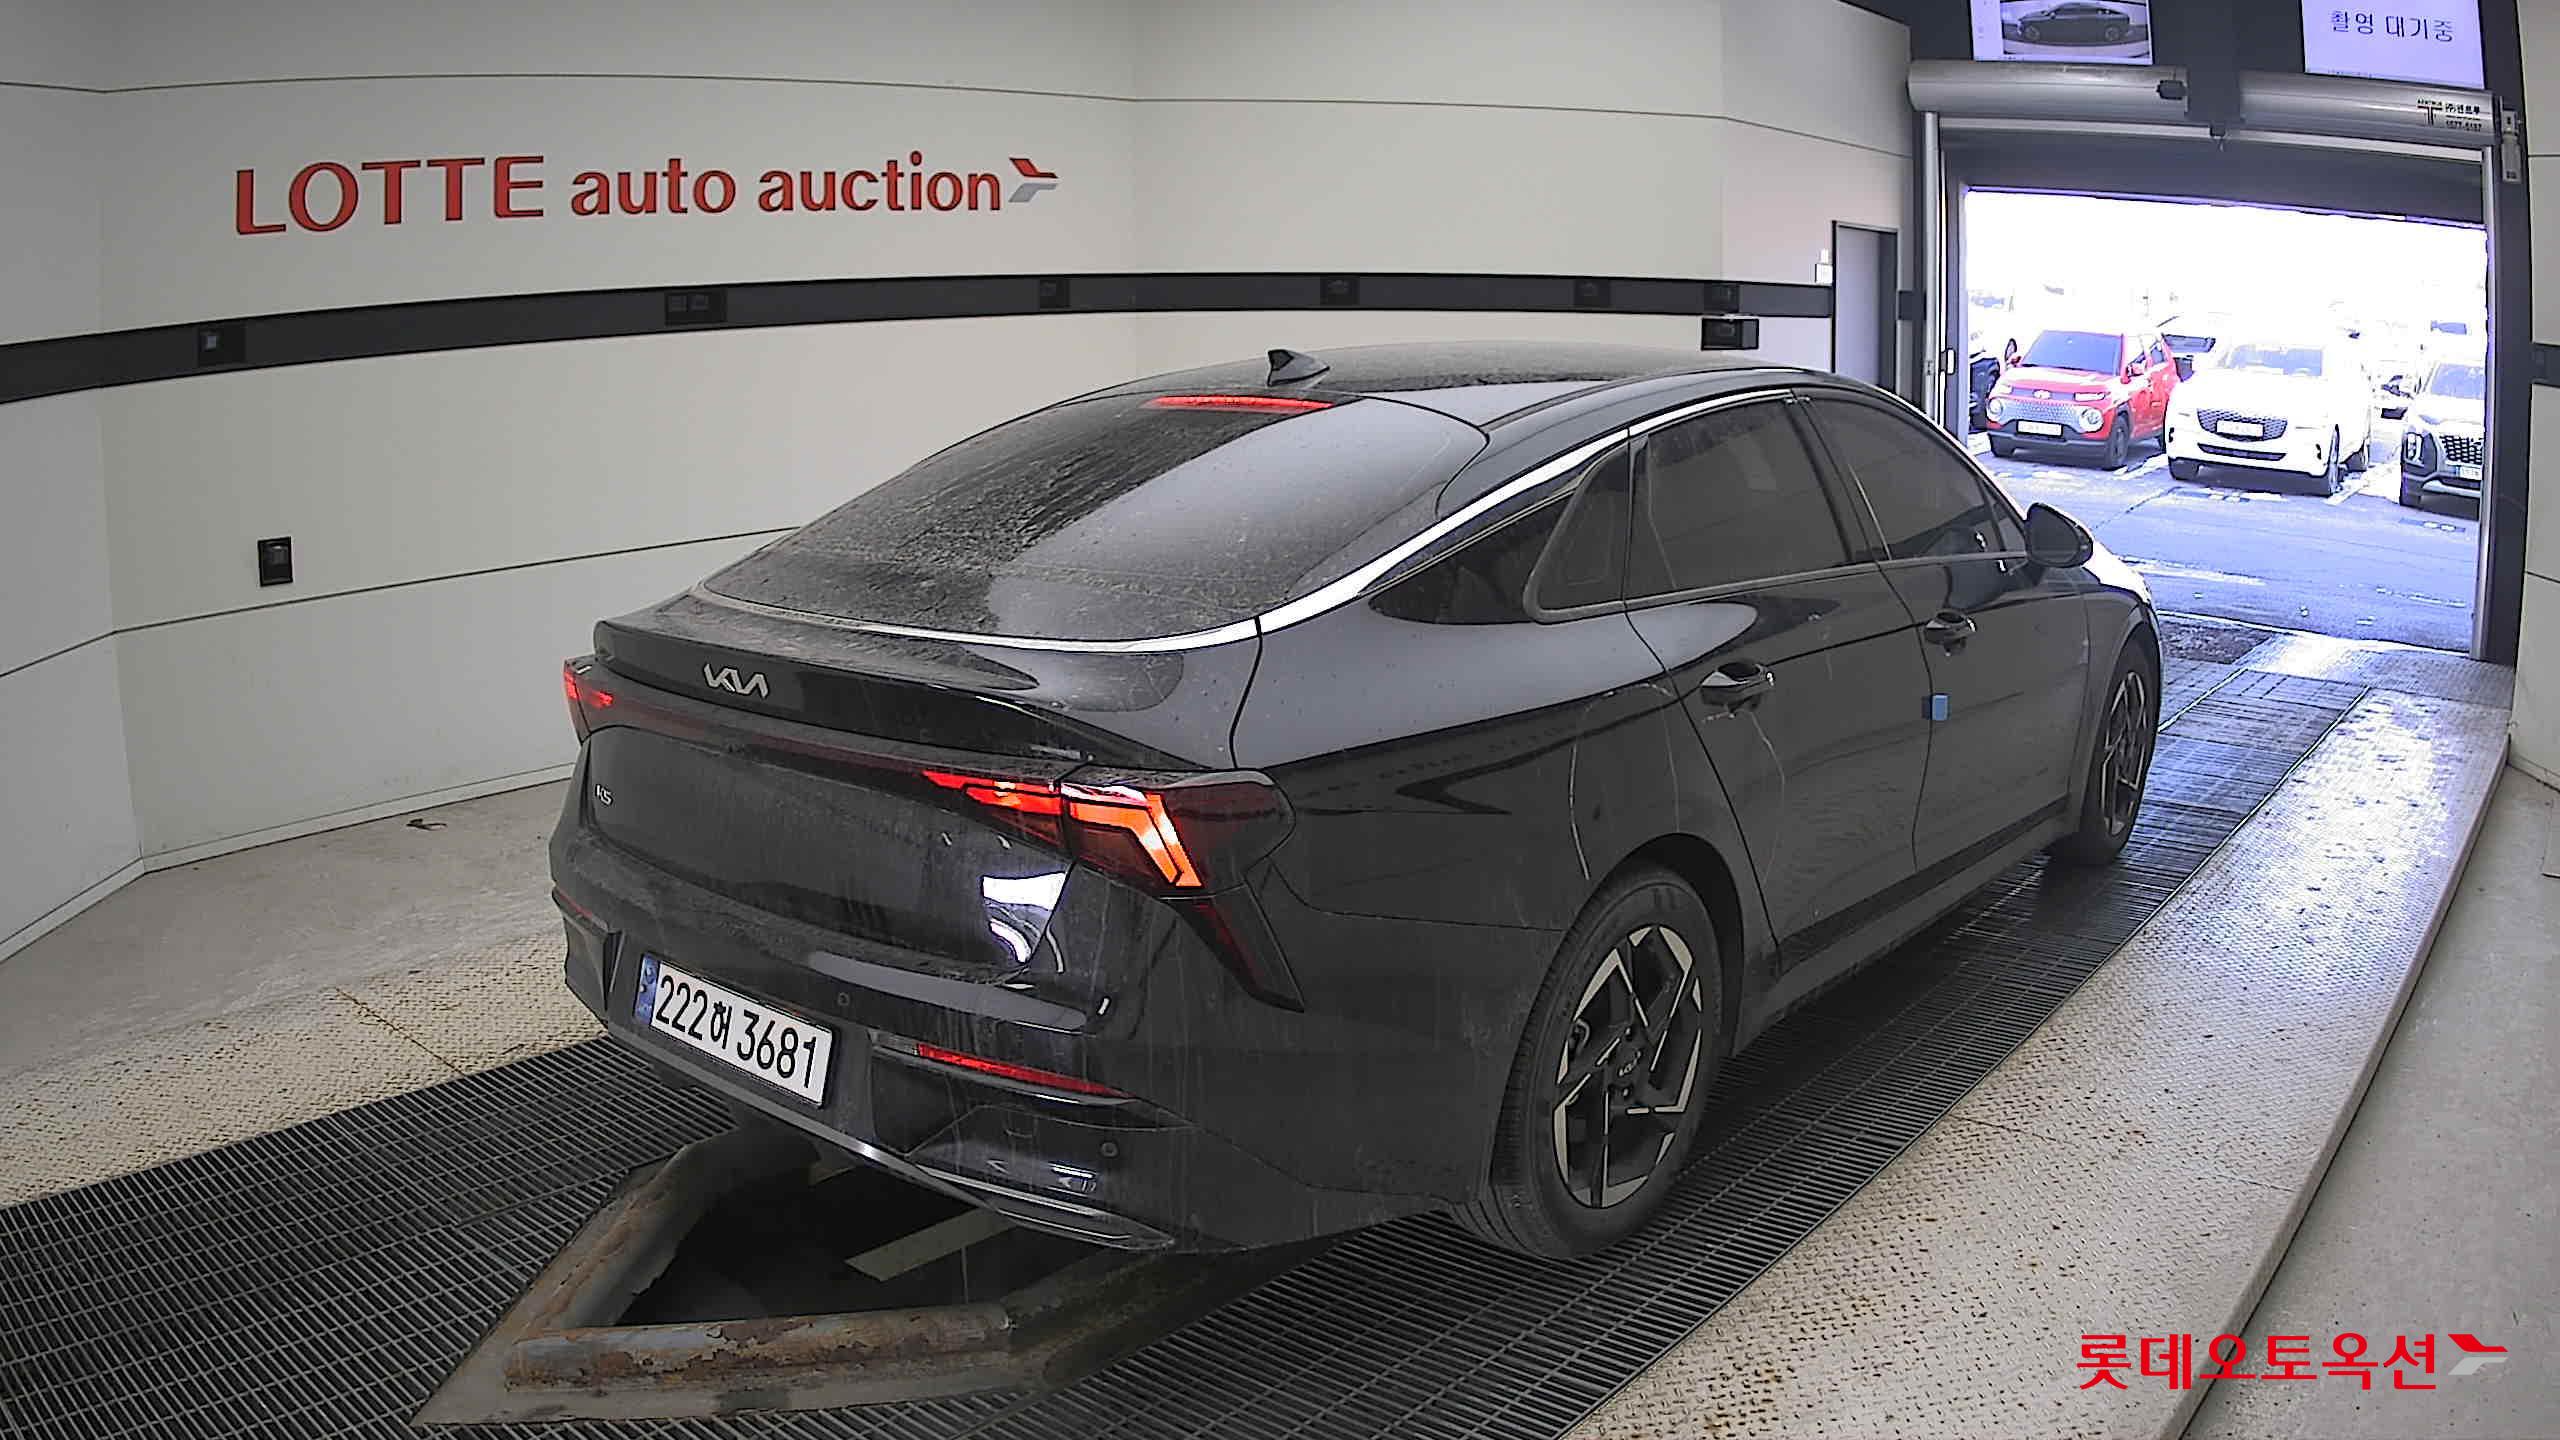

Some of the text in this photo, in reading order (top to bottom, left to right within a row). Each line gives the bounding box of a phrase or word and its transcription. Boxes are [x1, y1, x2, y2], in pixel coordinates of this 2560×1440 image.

[2331, 10, 2453, 42] 촬영 대기중
[236, 150, 1001, 235] LOTTE auto auction
[703, 663, 769, 699] KIA
[655, 974, 817, 1089] 222허 3681
